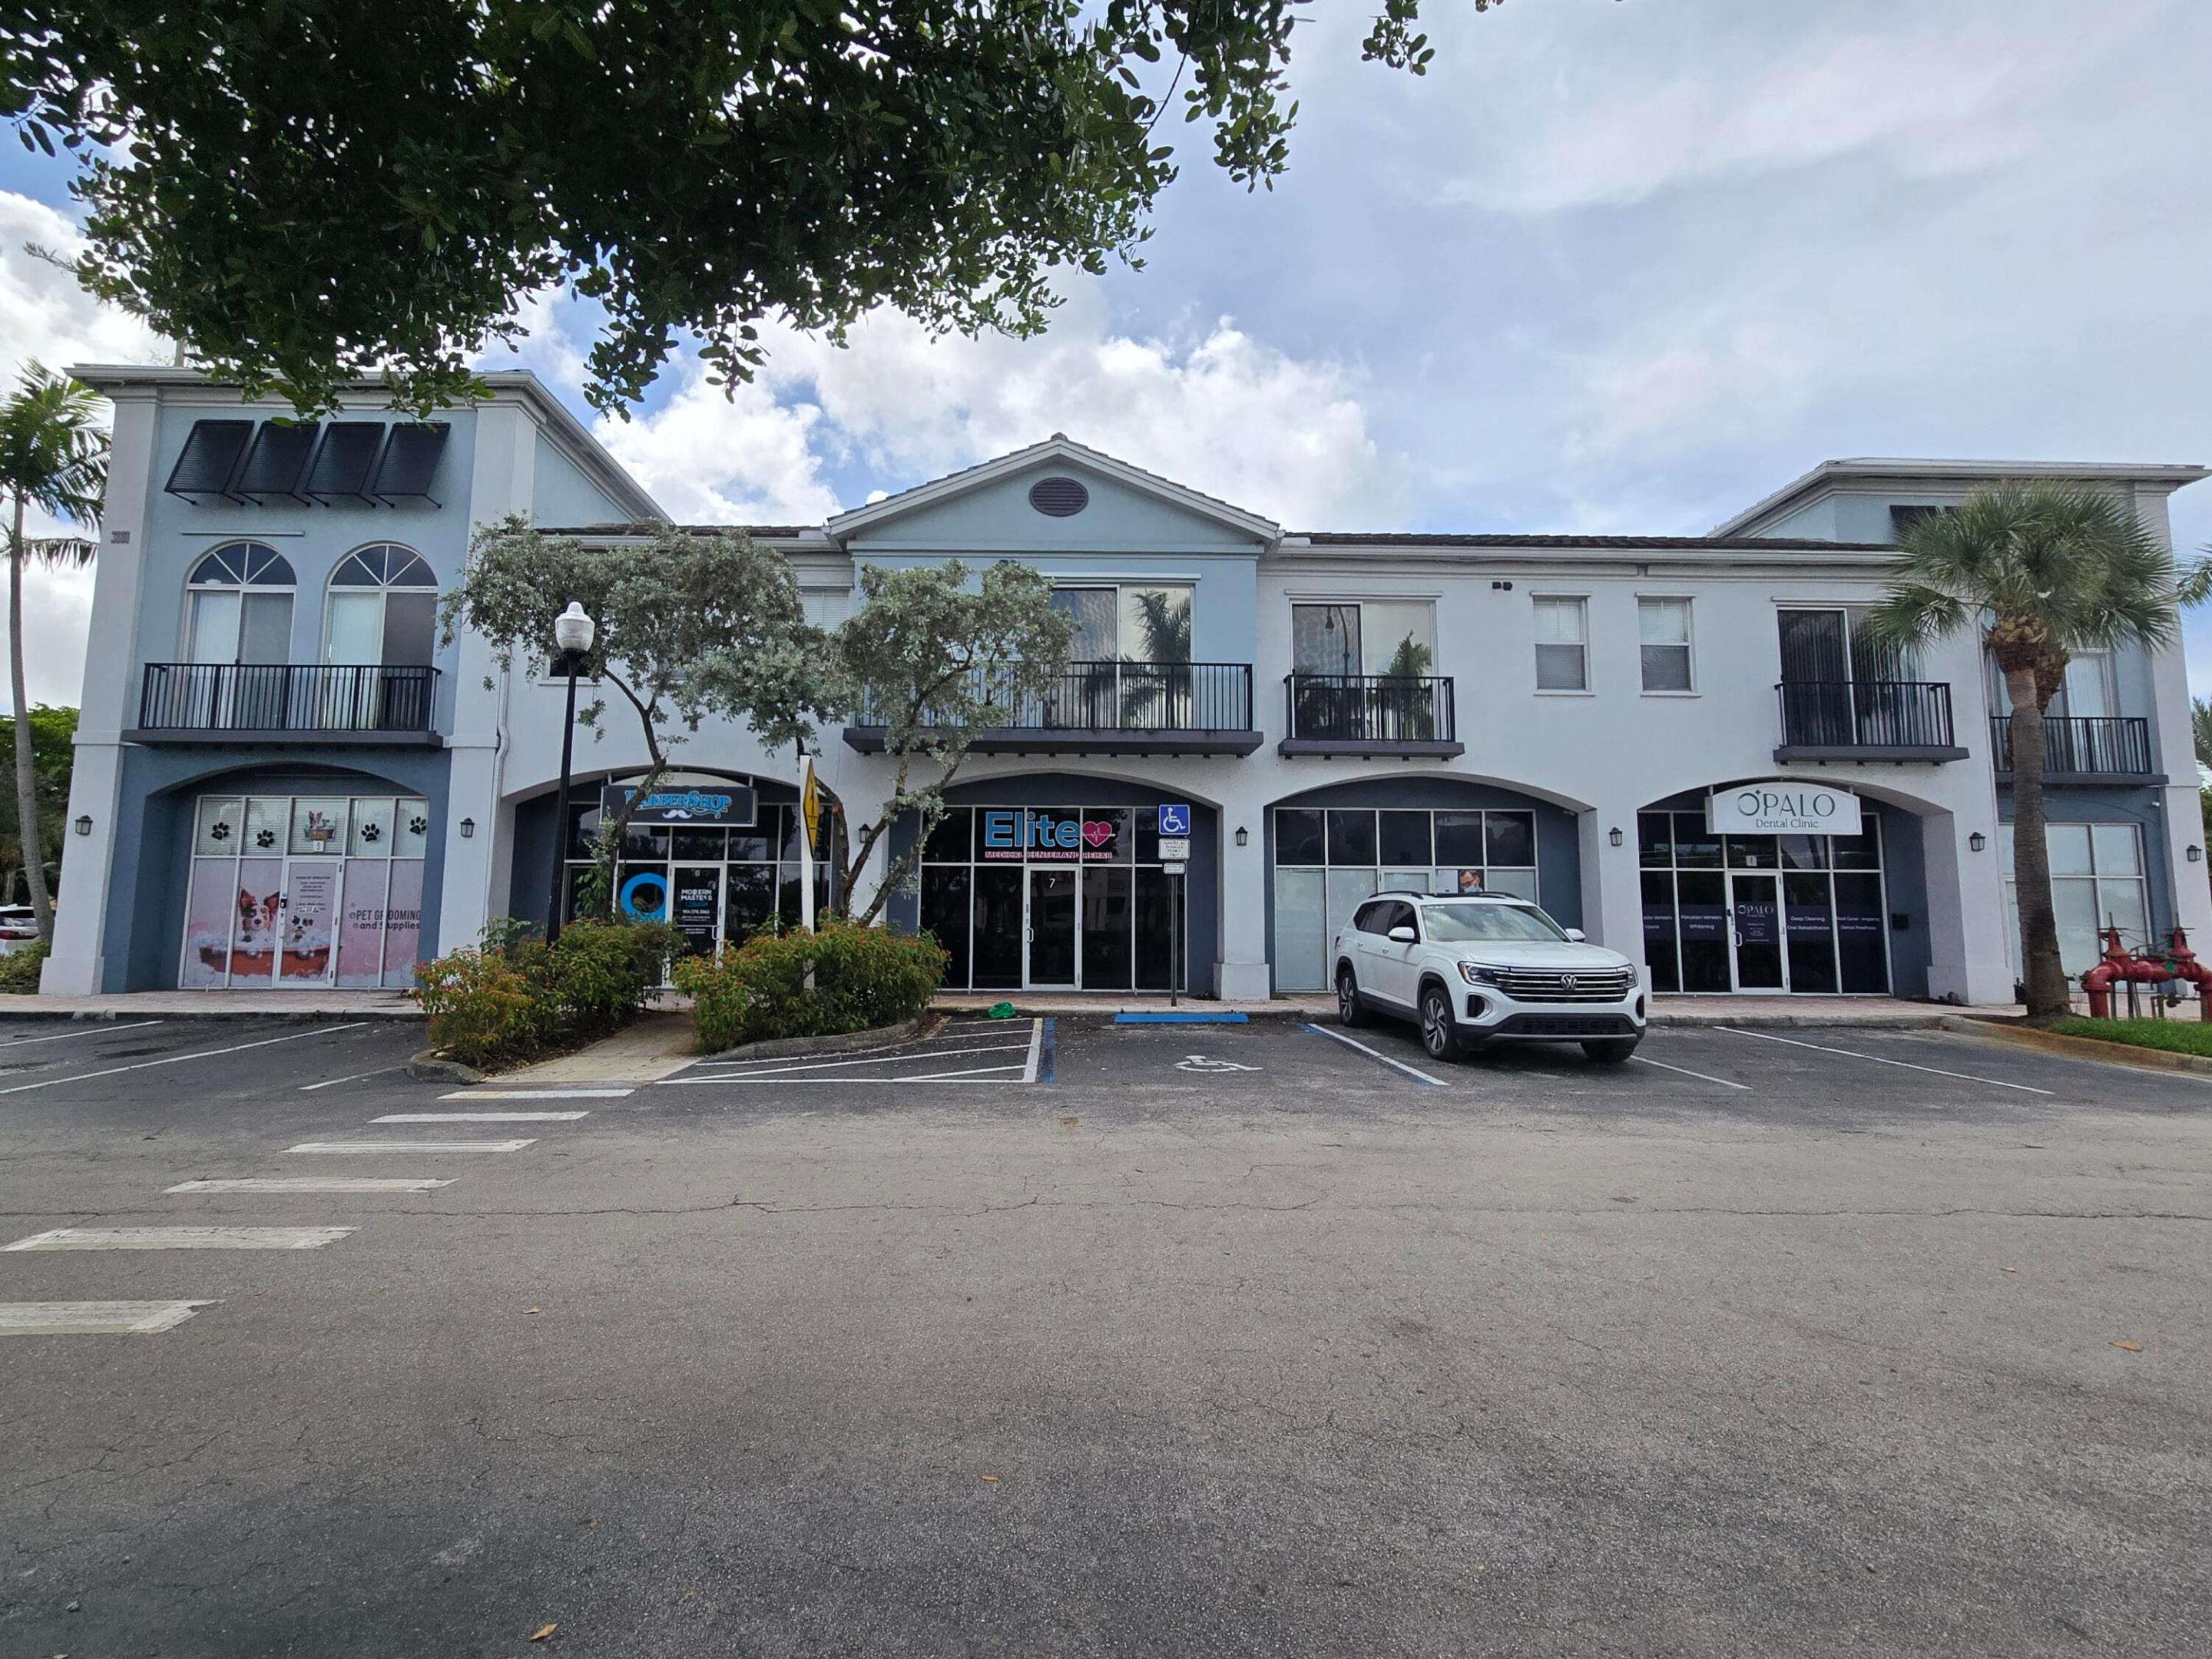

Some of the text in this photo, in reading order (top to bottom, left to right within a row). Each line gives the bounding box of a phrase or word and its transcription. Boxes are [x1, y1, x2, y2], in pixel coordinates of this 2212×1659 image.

[1737, 792, 1836, 817] OPALO
[1756, 819, 1819, 828] Dental Clinic
[985, 811, 1080, 847] Elite
[1049, 878, 1056, 888] 7
[356, 909, 373, 920] PET
[359, 921, 377, 929] and
